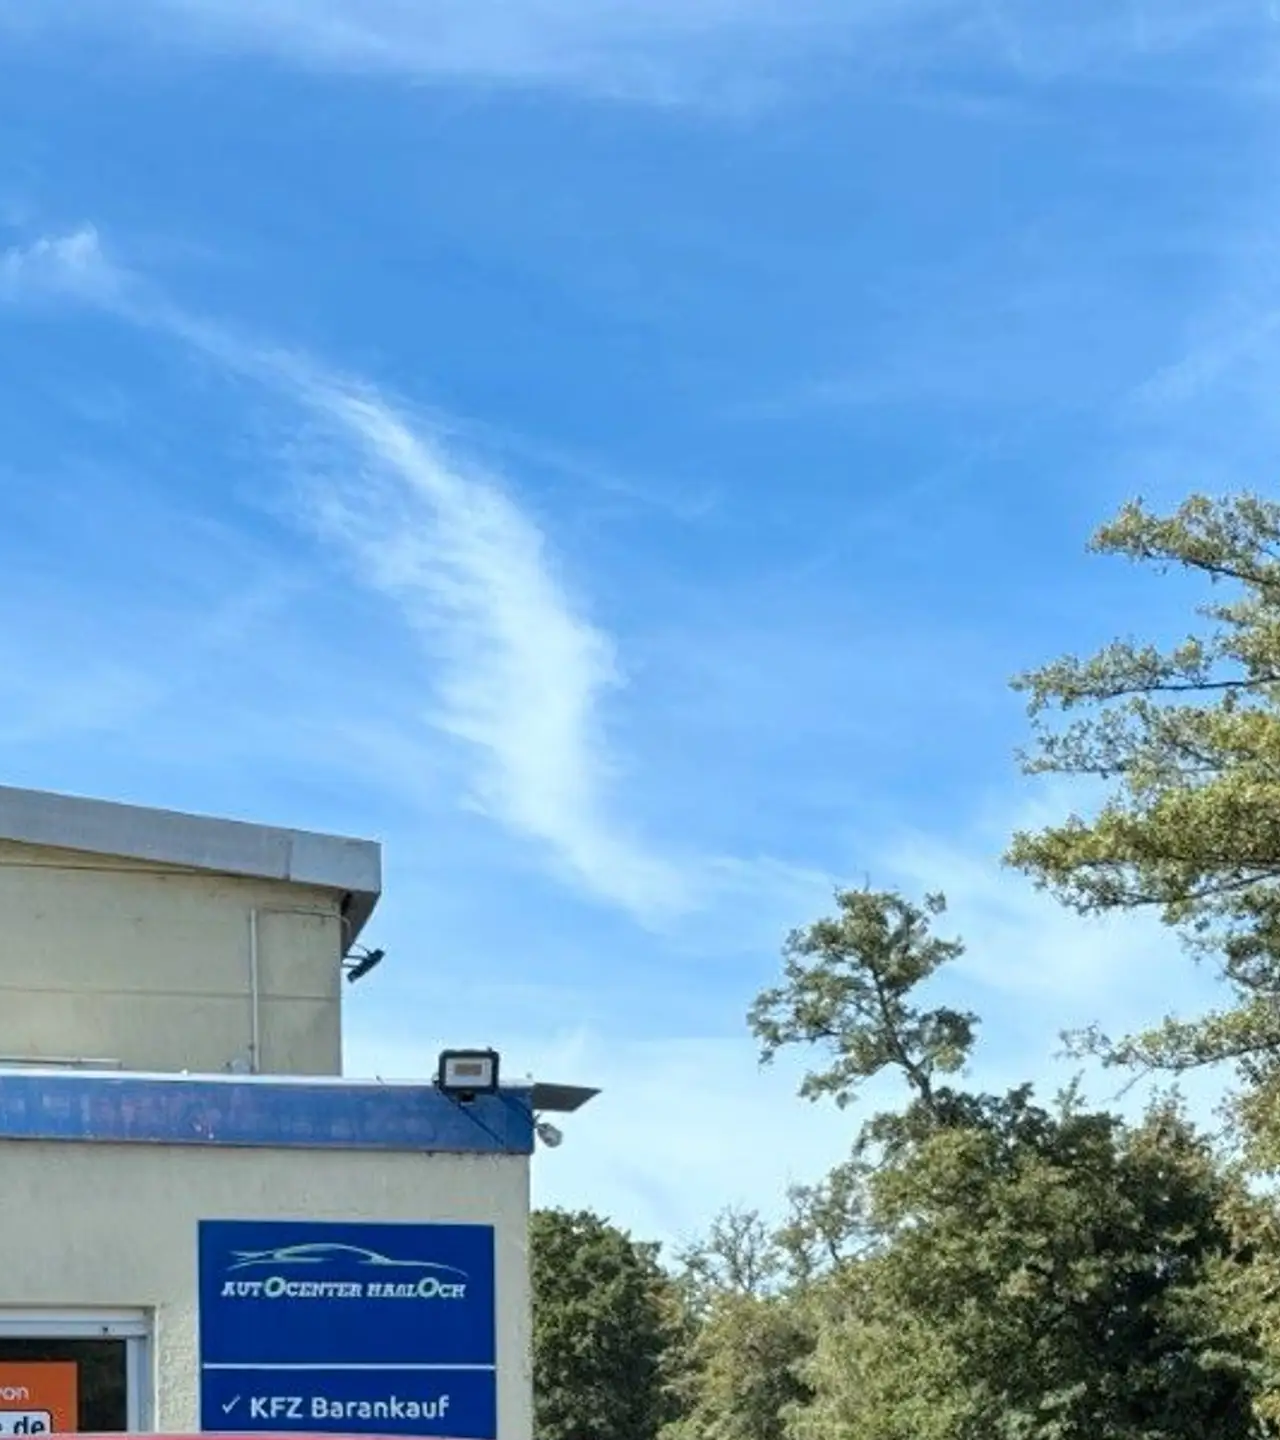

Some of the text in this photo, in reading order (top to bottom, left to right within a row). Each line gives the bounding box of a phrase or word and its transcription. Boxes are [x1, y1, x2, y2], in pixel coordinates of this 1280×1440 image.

[221, 1276, 363, 1298] AUTOCENTER
[250, 1395, 450, 1419] KFZ Barankauf
